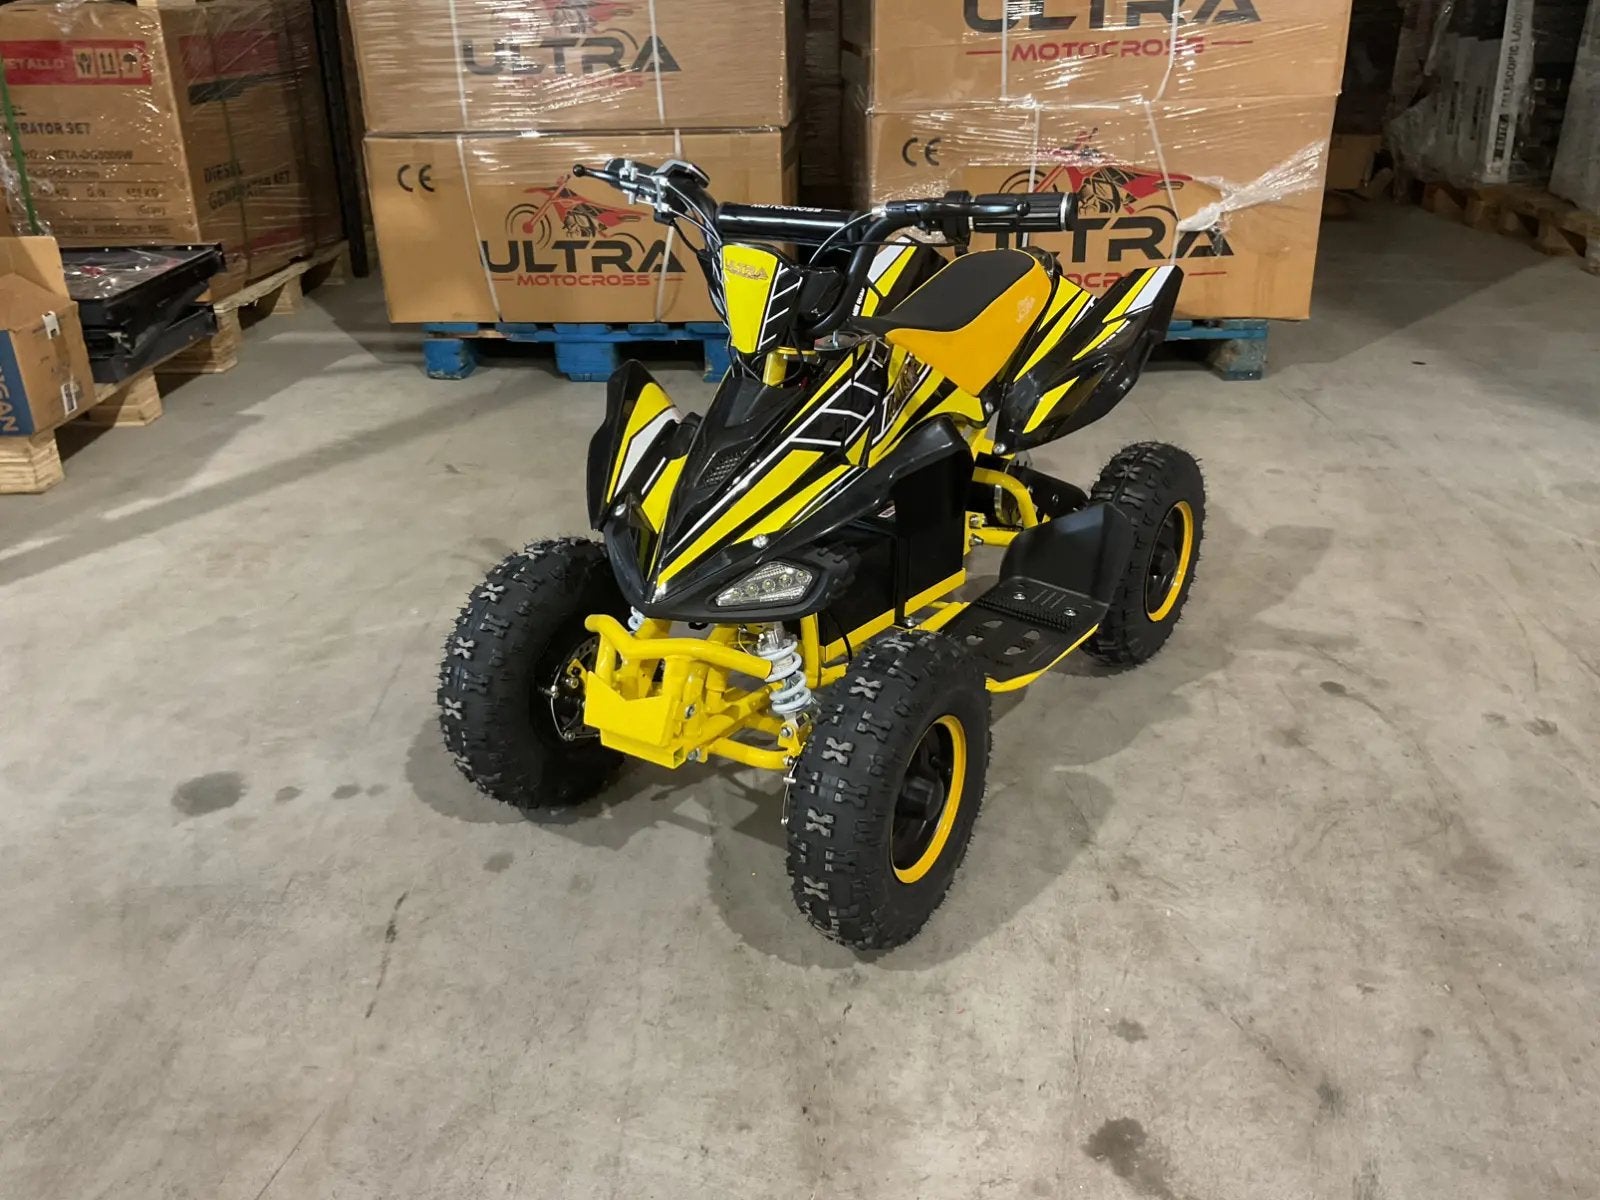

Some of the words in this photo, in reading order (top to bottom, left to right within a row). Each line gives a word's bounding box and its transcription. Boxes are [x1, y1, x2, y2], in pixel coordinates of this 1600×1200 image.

[461, 35, 682, 75] ULTRA
[1011, 36, 1205, 62] MOTOCROSS
[66, 122, 90, 134] SET
[396, 164, 435, 192] CE
[750, 203, 823, 213] MOTOCROSS
[480, 240, 687, 273] ULTRA
[516, 274, 652, 287] MOTOCROSS
